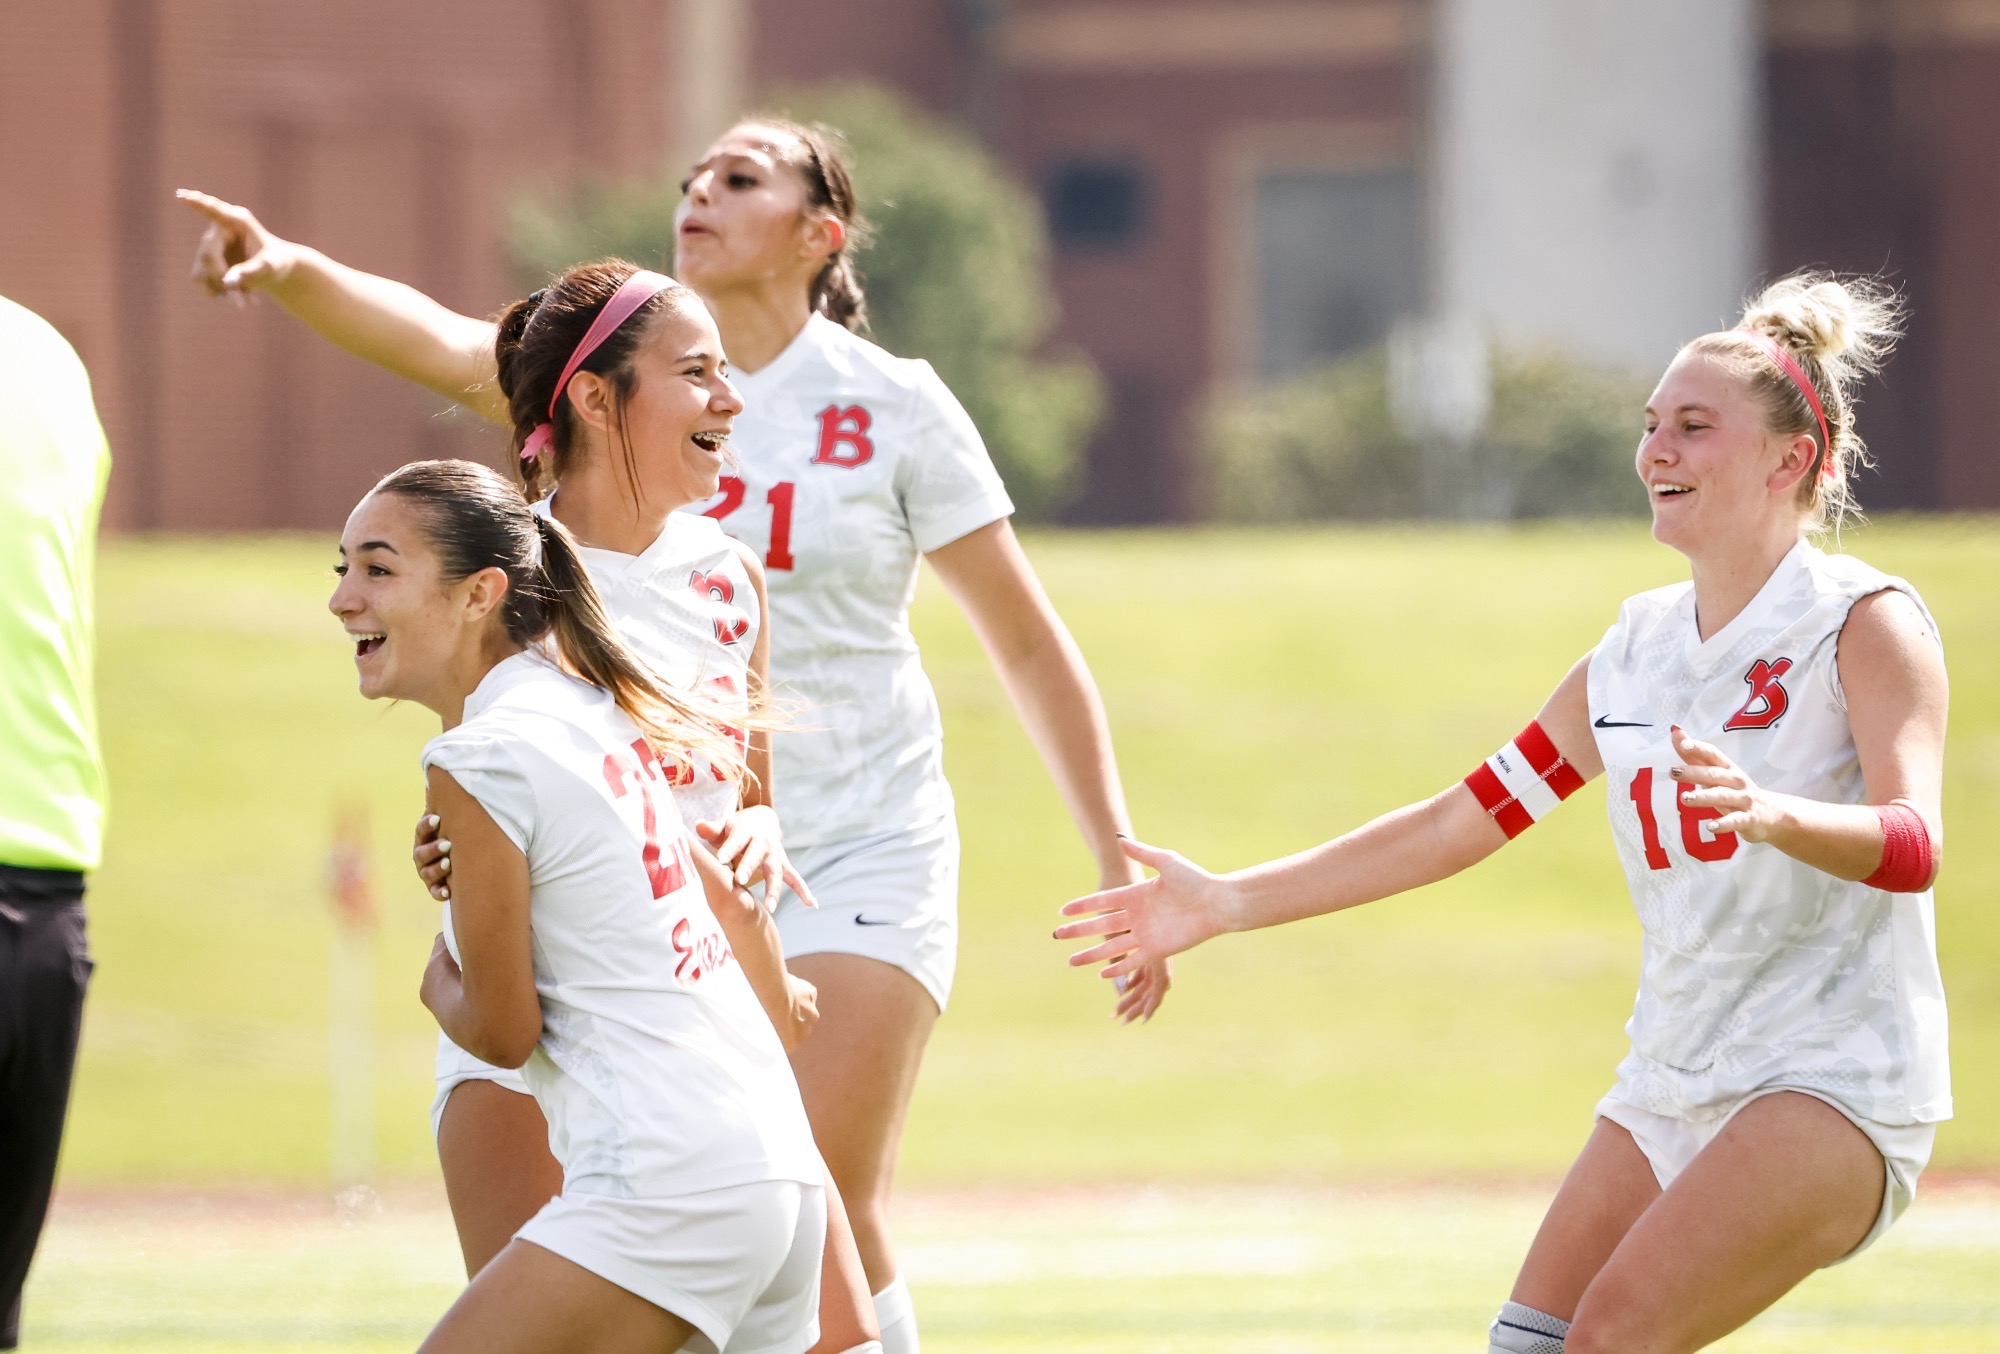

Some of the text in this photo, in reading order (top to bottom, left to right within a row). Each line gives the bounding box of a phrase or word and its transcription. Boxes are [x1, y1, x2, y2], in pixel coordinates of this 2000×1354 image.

[810, 403, 875, 470] B
[701, 475, 795, 571] 21
[1723, 656, 1793, 732] B
[1630, 766, 1739, 870] 16
